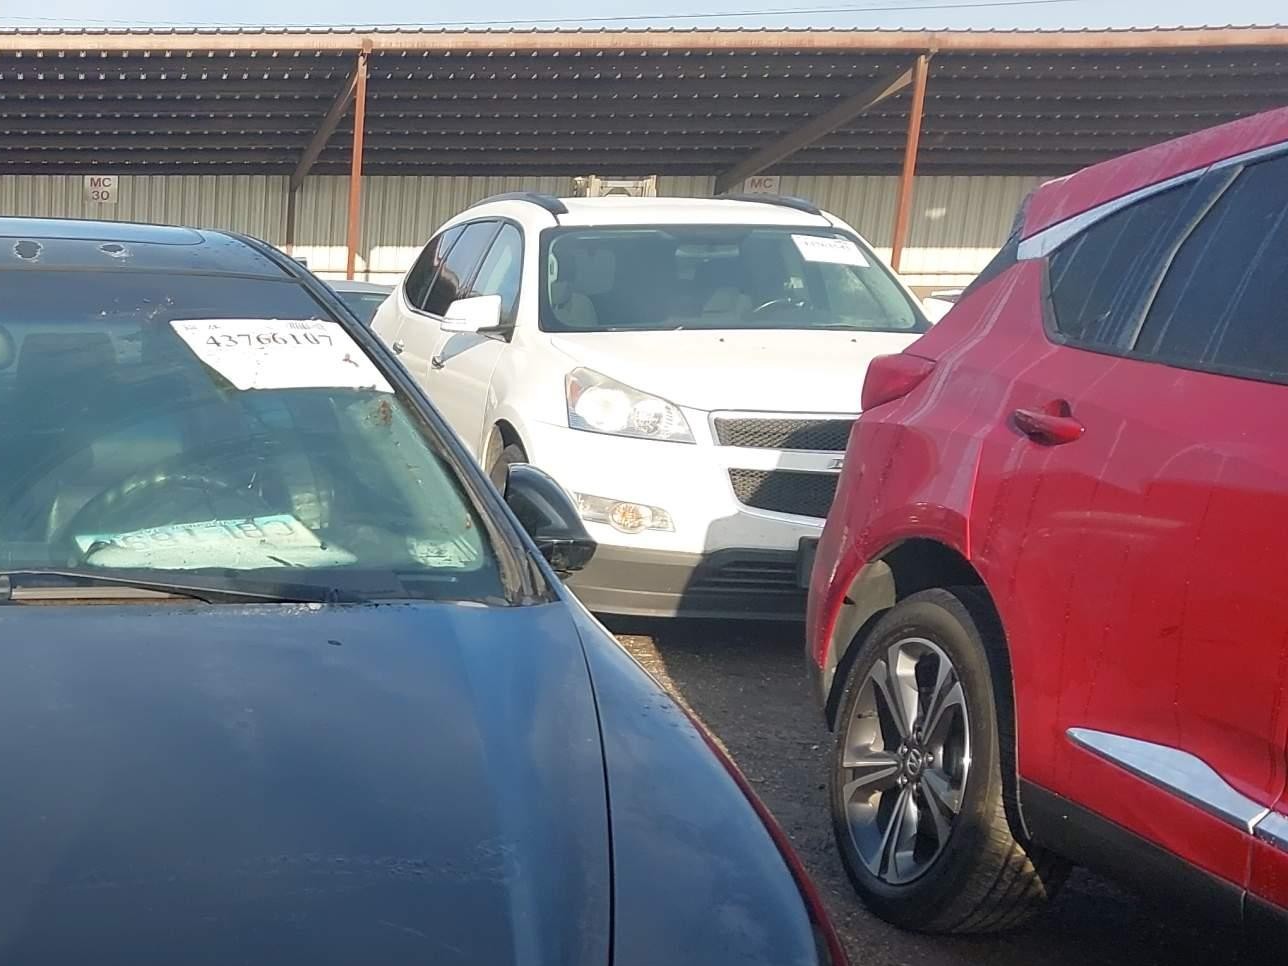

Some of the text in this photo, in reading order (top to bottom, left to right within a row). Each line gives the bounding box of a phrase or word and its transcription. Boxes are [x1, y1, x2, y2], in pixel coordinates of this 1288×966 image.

[90, 177, 112, 188] MC
[750, 177, 774, 189] MC
[91, 190, 110, 201] 30
